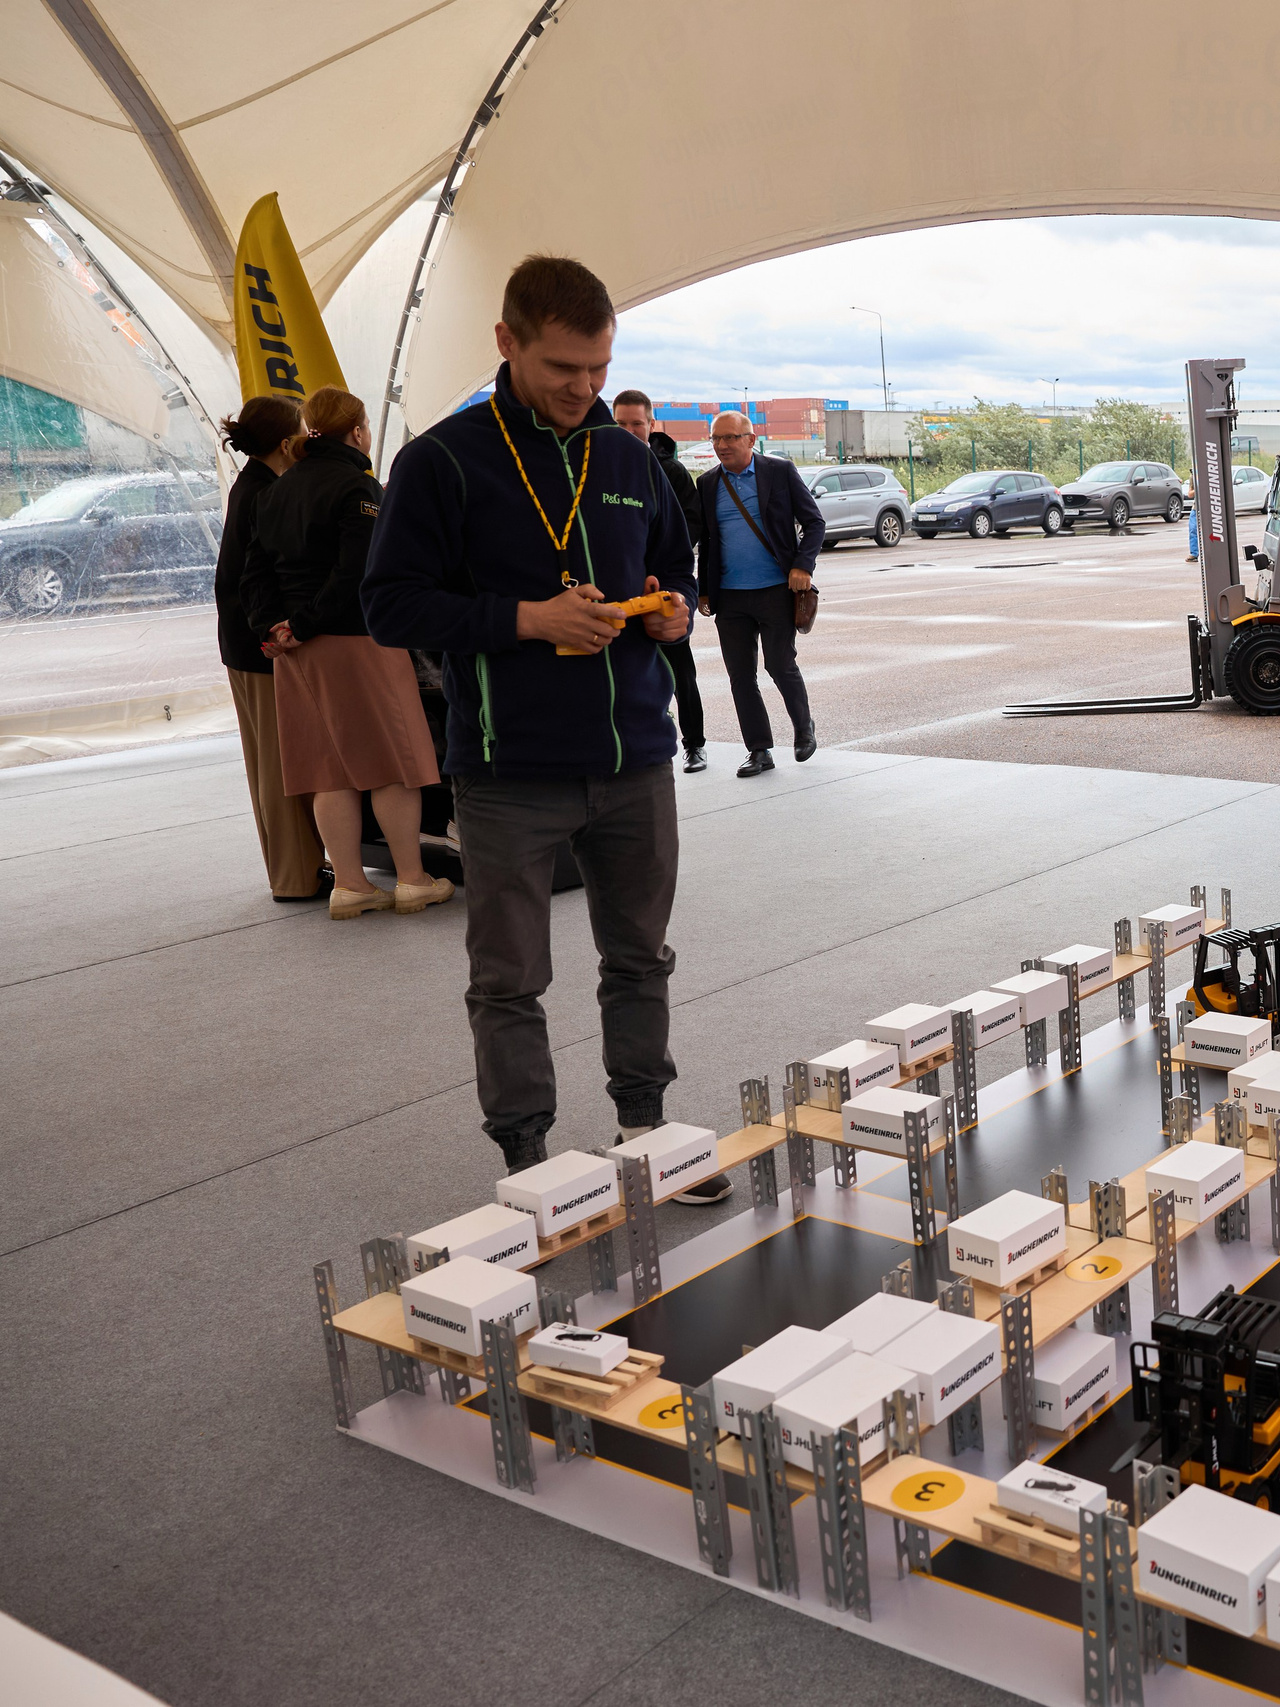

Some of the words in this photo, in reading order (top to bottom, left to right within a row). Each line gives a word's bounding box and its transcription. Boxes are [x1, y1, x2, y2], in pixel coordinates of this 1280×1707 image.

[603, 493, 620, 504] P&G
[1206, 441, 1225, 543] JUNGHEINRICH
[1080, 965, 1111, 983] JUNGHEINRICH
[981, 1012, 1016, 1034] JUNGHEINRICH
[910, 1026, 948, 1049] JUNGHEINRICH
[1191, 1040, 1242, 1056] JUNGHEINRICH
[855, 1064, 894, 1088] JUNGHEINRICH
[850, 1120, 903, 1141] JUNGHEINRICH
[659, 1150, 712, 1182] JUNGHEINRICH
[1175, 1194, 1194, 1205] LIFT
[1204, 1172, 1241, 1205] JUNGHEINRICH
[551, 1183, 612, 1218] JUNGHEINRICH
[483, 1240, 528, 1263] HEINRICH
[1007, 1226, 1060, 1265] JUNGHEINRICH
[965, 1252, 994, 1268] JHLIFT
[410, 1305, 467, 1335] JUNGHEINRICH
[940, 1352, 995, 1401] JUNGHEINRICH
[1065, 1365, 1110, 1410] JUNGHEINRICH
[914, 1481, 946, 1502] 3
[1149, 1560, 1238, 1609] JUNGHEINRICH
